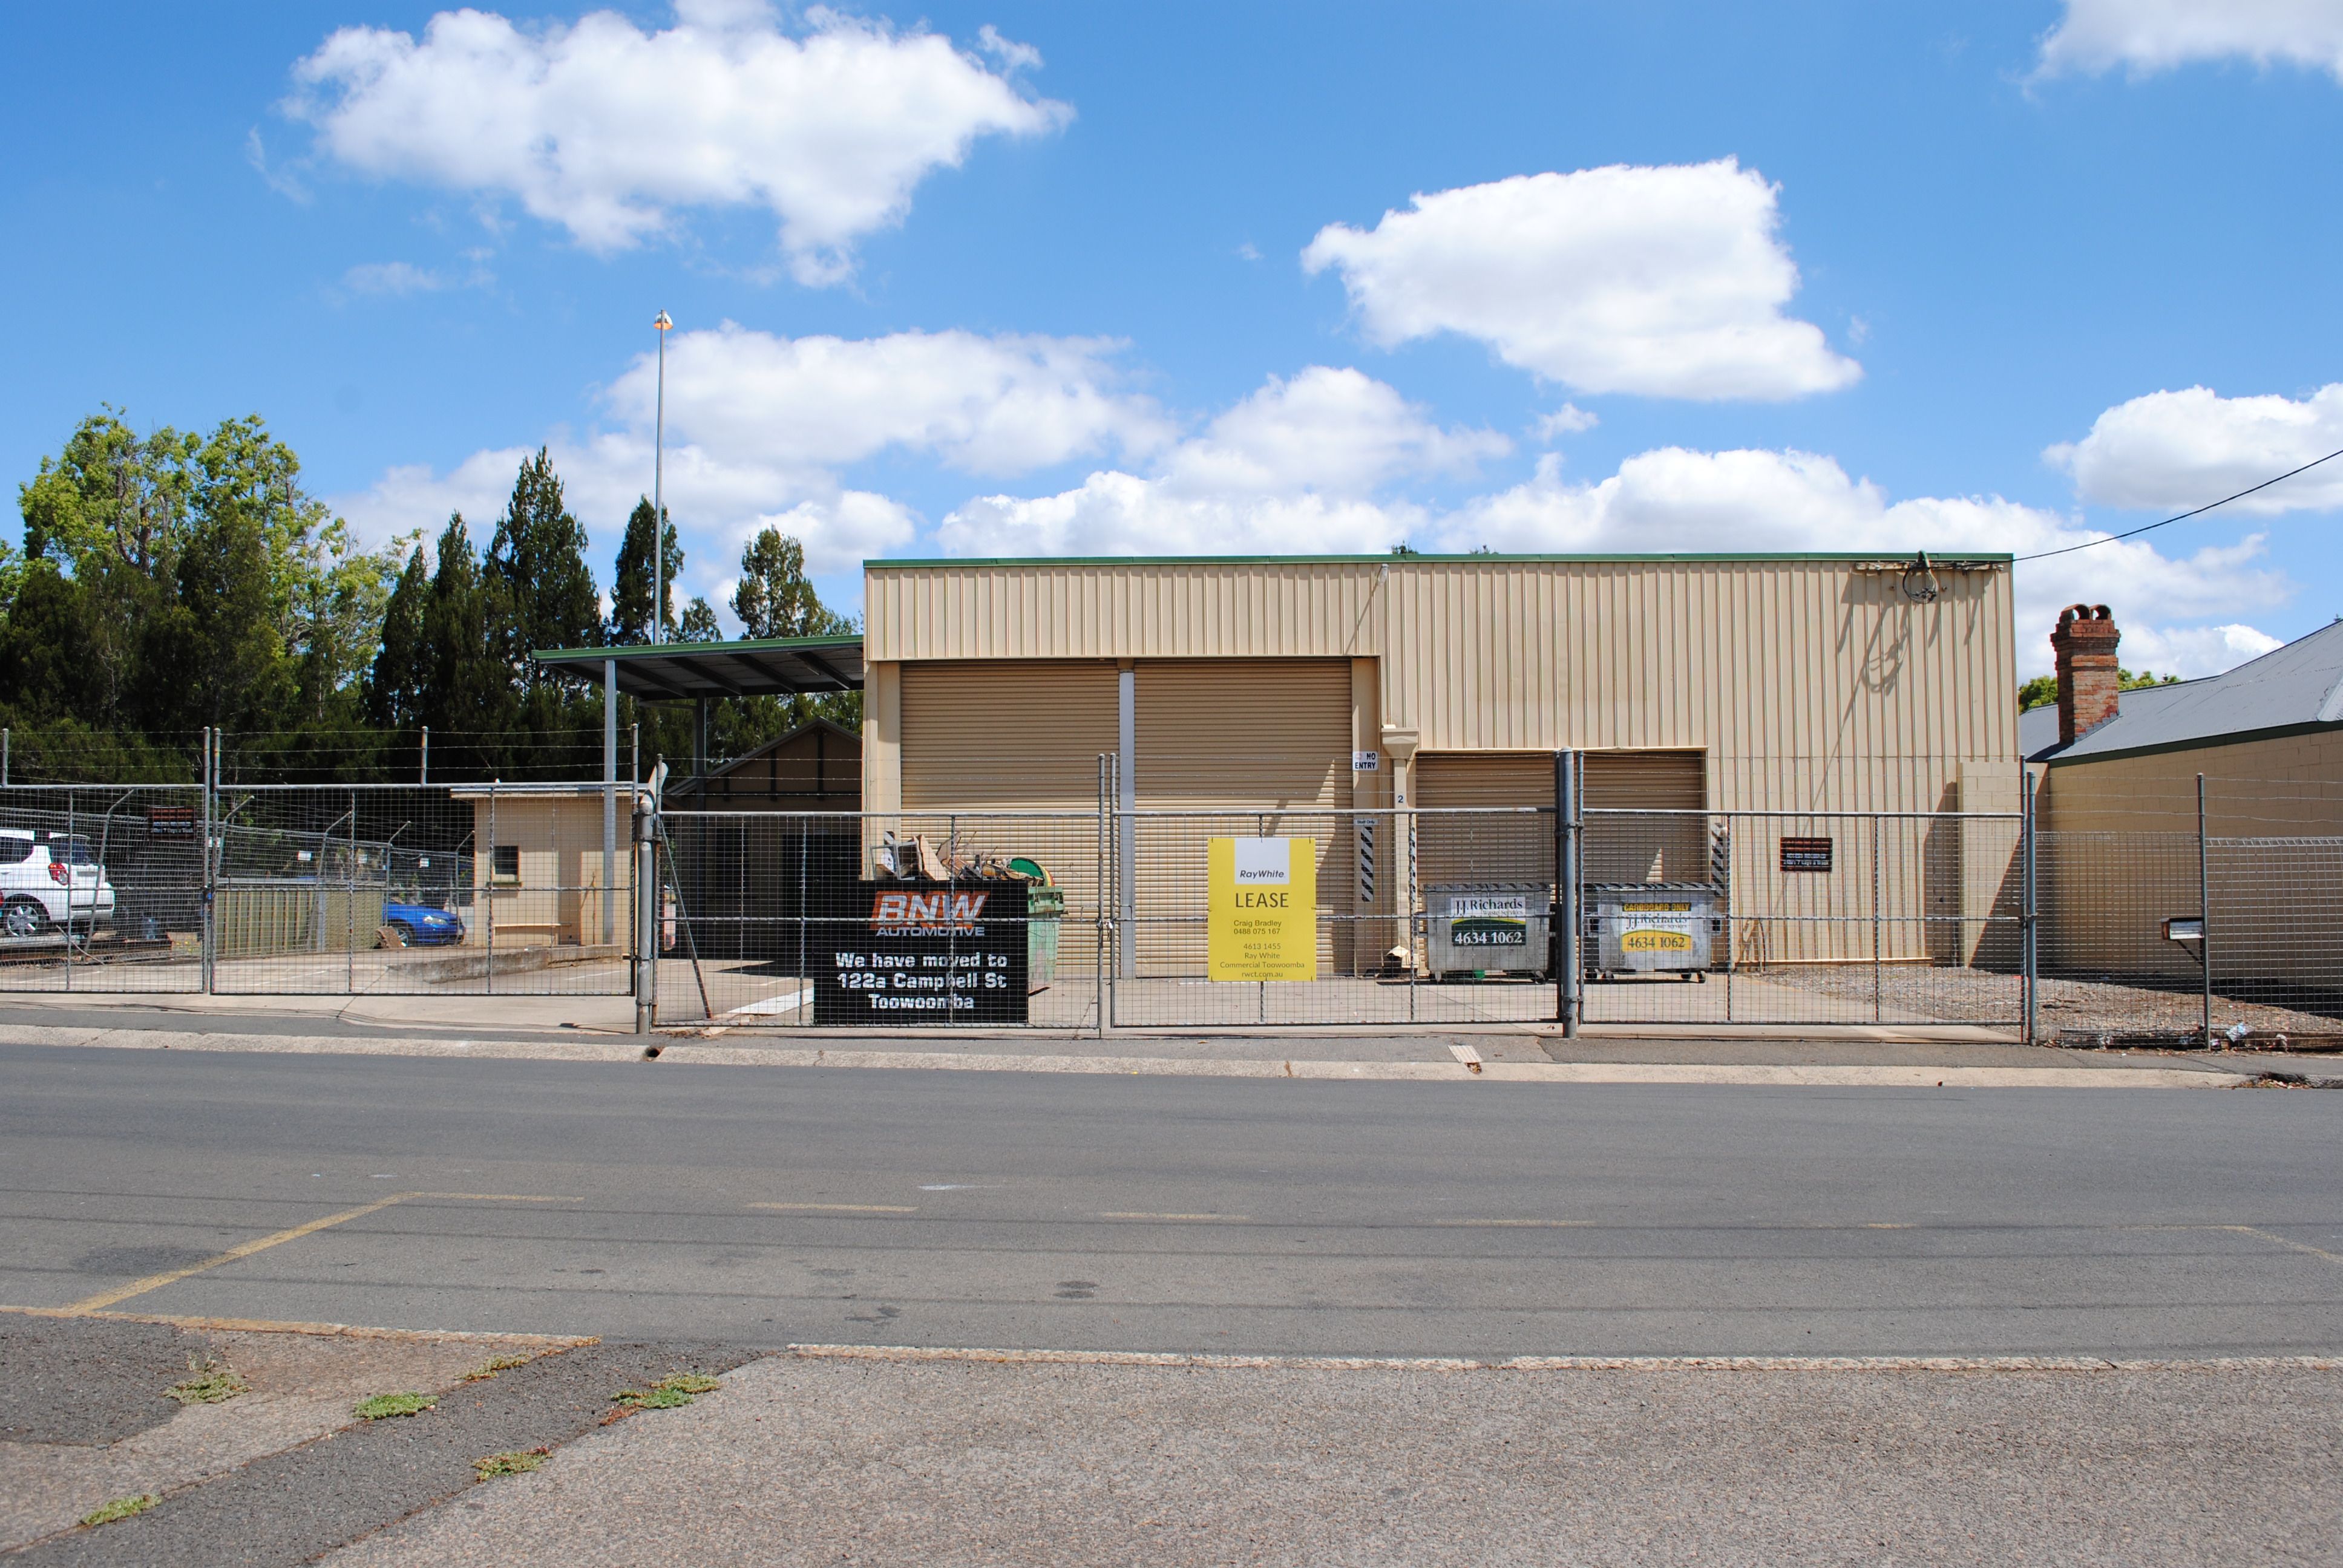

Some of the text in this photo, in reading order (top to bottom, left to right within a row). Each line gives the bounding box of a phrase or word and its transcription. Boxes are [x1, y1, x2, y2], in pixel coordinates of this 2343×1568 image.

[1235, 892, 1289, 908] LEASE
[876, 894, 986, 926] BNW
[876, 927, 985, 937] AUTOMOTIVE
[1455, 932, 1522, 944] 4634 1062
[1628, 936, 1685, 949] 4634 1062
[836, 952, 1008, 968] We have moved to
[837, 972, 1008, 991] 122a Campbell St
[868, 993, 975, 1009] Toowoomba
